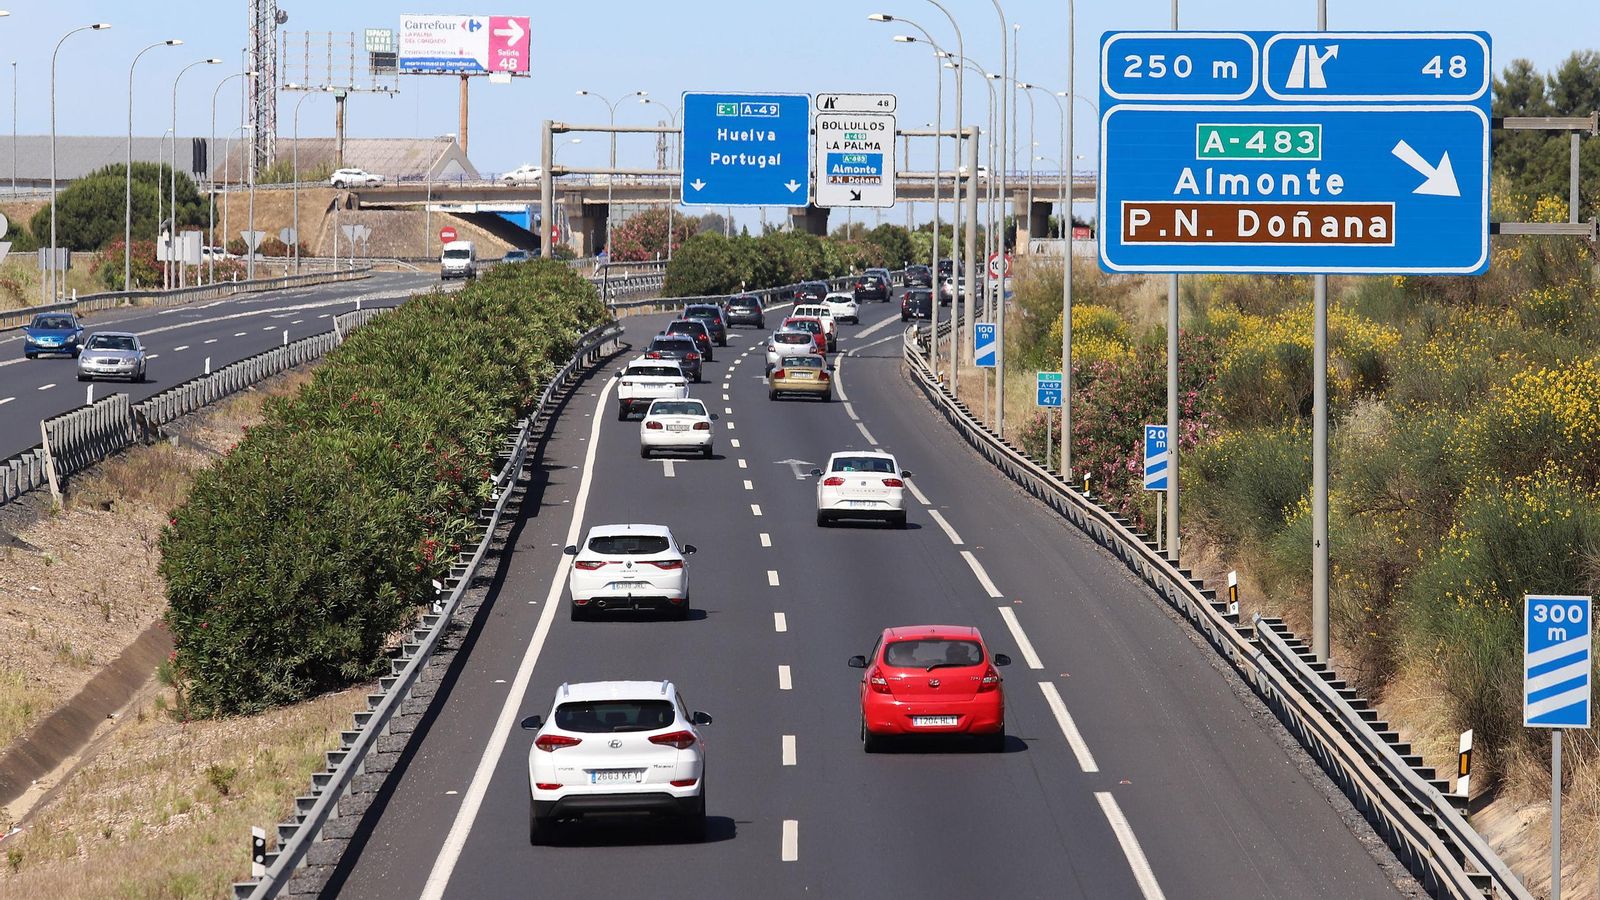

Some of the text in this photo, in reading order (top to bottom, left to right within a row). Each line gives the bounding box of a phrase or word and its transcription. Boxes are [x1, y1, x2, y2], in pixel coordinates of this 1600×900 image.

[405, 20, 456, 30] Carrefour
[499, 58, 518, 69] 48
[1123, 54, 1238, 79] 250 m
[1421, 55, 1467, 79] 48
[718, 105, 777, 115] E-1 A-49
[822, 121, 885, 131] BOLLULLOS
[717, 128, 776, 141] Huelva
[826, 141, 881, 150] LA PALMA
[1203, 130, 1315, 154] A-483
[710, 152, 781, 168] Portugal
[832, 164, 877, 174] Almonte
[1173, 167, 1345, 196] Almonte
[1129, 209, 1387, 239] P.N. Doñana
[1043, 396, 1057, 404] 47
[1149, 430, 1168, 439] 20
[1534, 604, 1583, 624] 300
[1547, 627, 1567, 641] m
